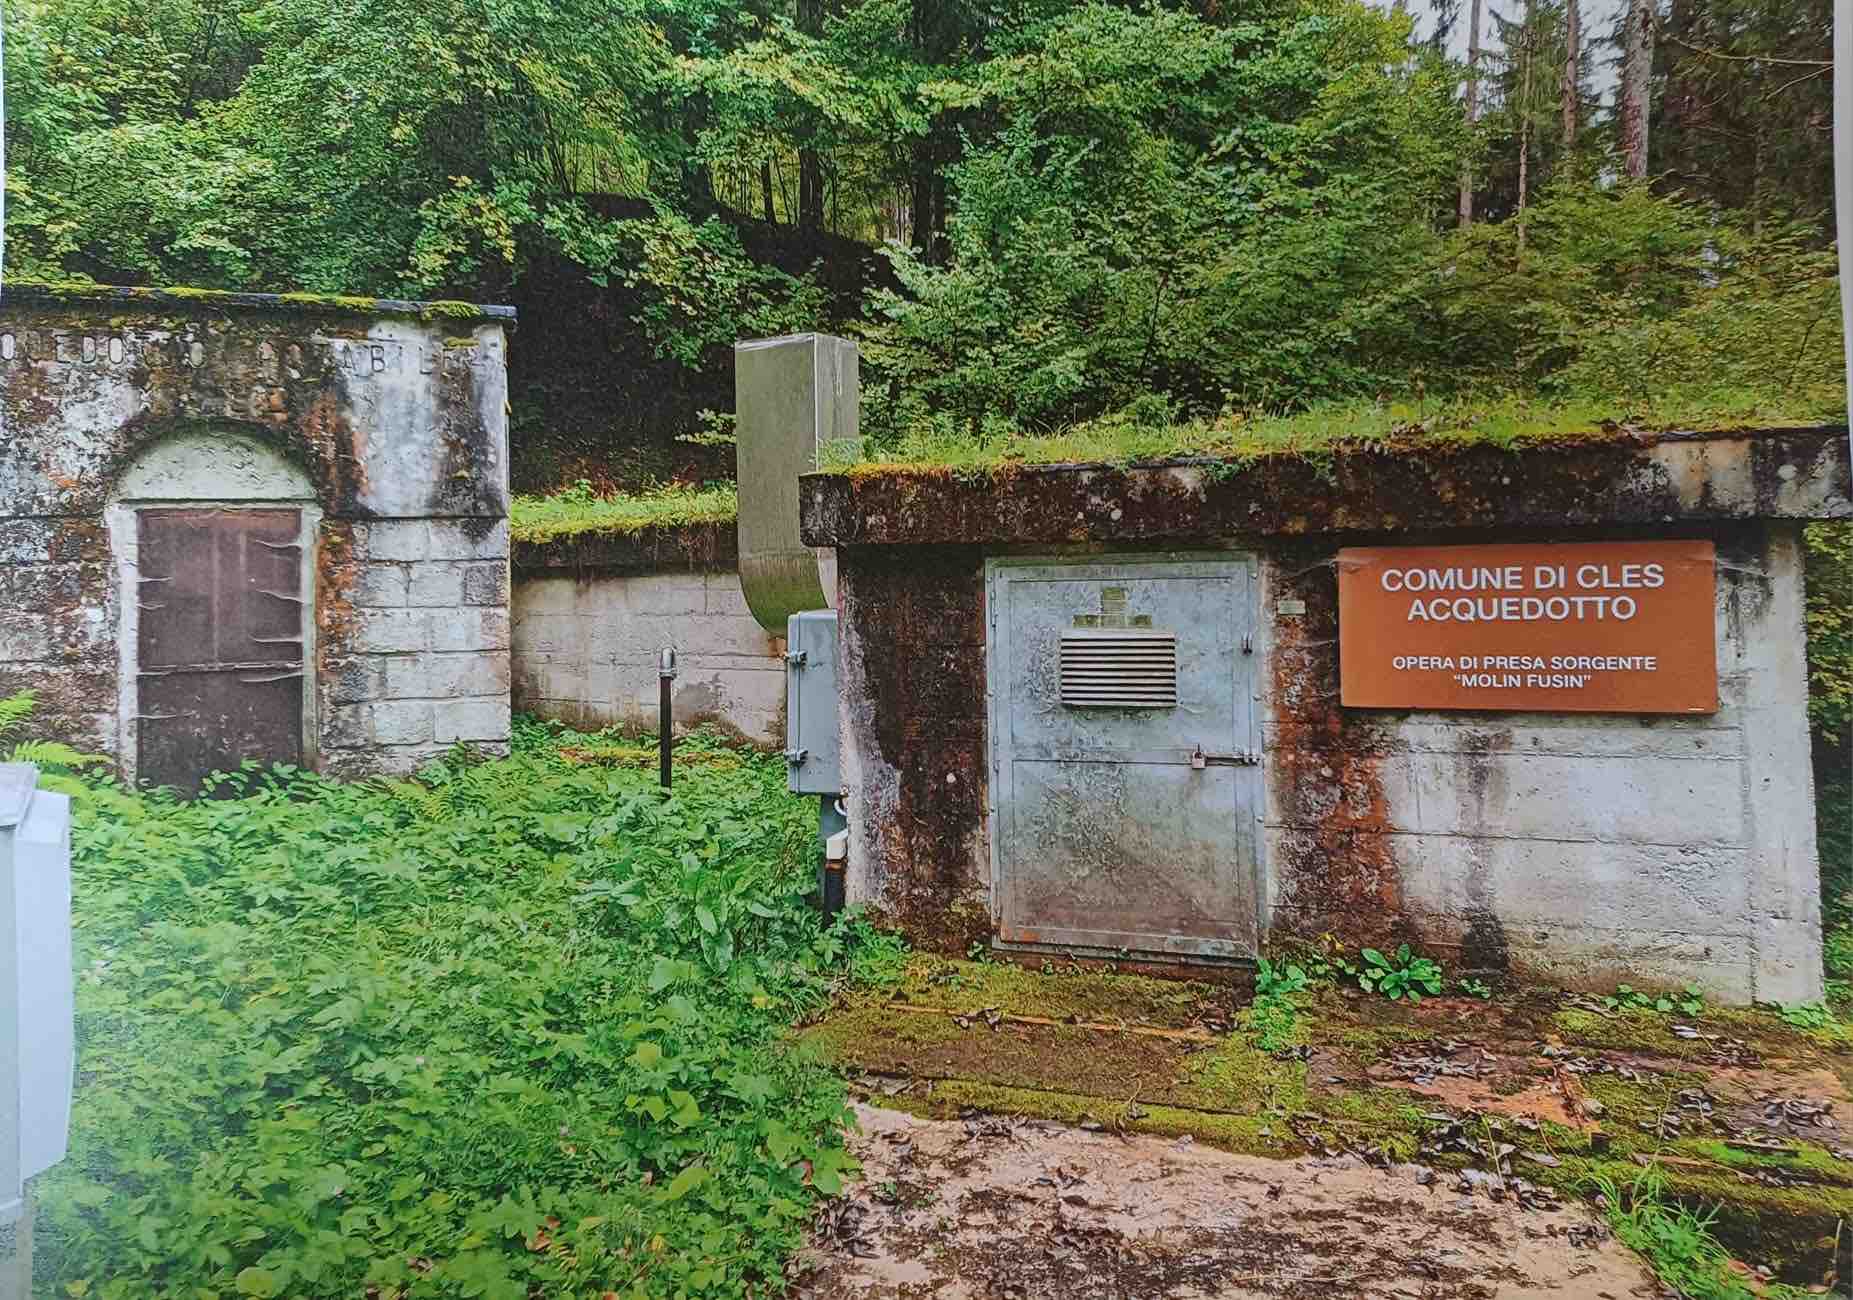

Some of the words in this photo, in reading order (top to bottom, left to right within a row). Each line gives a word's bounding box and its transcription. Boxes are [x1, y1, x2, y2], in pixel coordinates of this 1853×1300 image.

[1381, 566, 1524, 591] COMUNE
[1534, 565, 1566, 588] DI
[1575, 563, 1665, 588] CLES
[1407, 595, 1637, 621] ACQUEDOTTO
[1392, 655, 1455, 669] OPERA
[1459, 656, 1479, 669] DI
[1482, 655, 1547, 670] PRESA
[1550, 655, 1657, 670] SORGENTE
